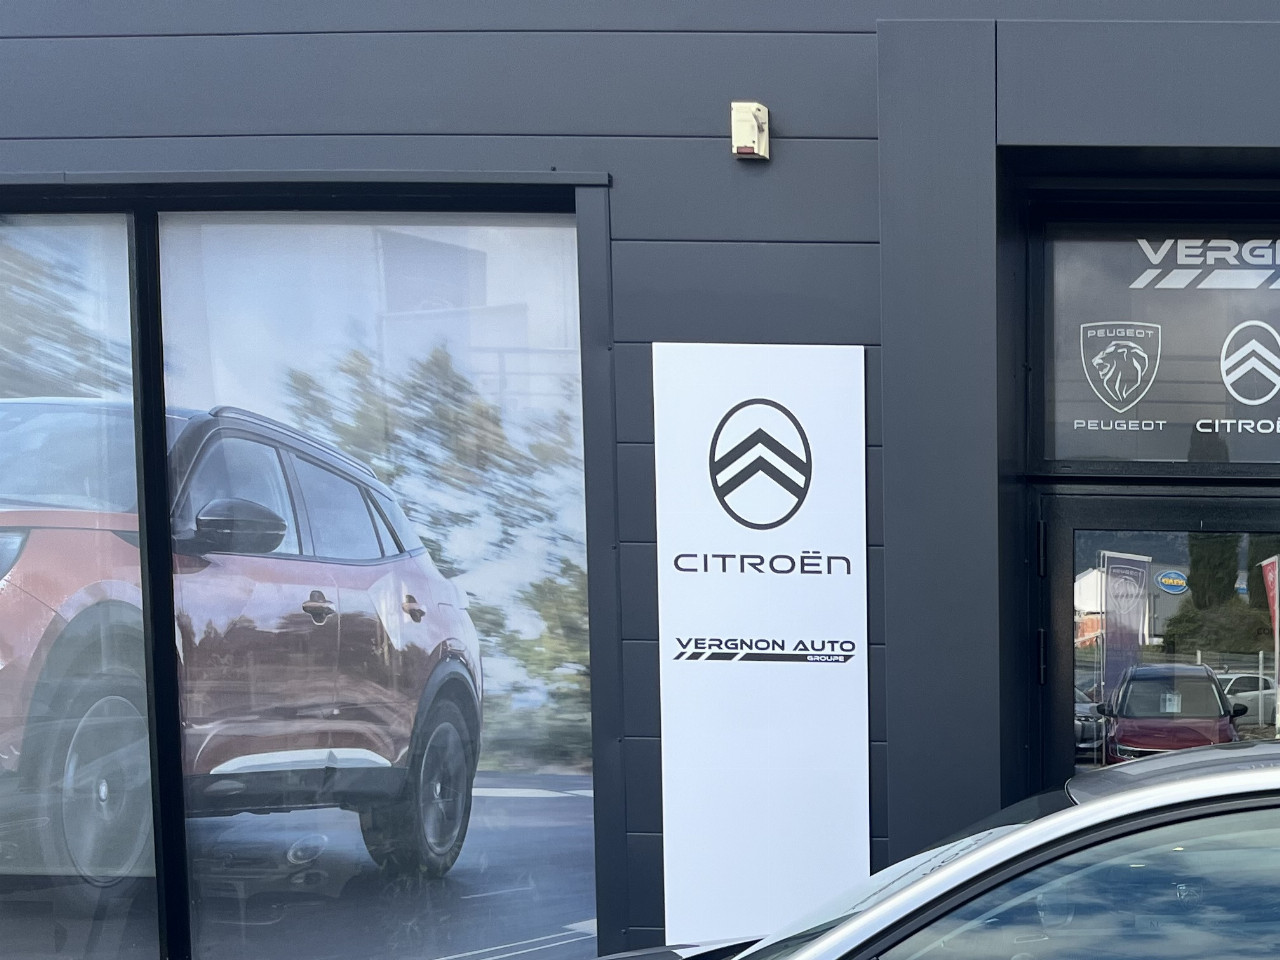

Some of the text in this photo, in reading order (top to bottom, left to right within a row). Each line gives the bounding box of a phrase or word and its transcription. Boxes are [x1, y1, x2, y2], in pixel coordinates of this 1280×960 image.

[1087, 328, 1155, 339] PEUGEOT
[1073, 419, 1167, 431] PEUGEOT
[673, 550, 851, 575] CITROËN
[675, 637, 856, 653] VERGNON AUTO
[806, 654, 845, 662] GROUPE
